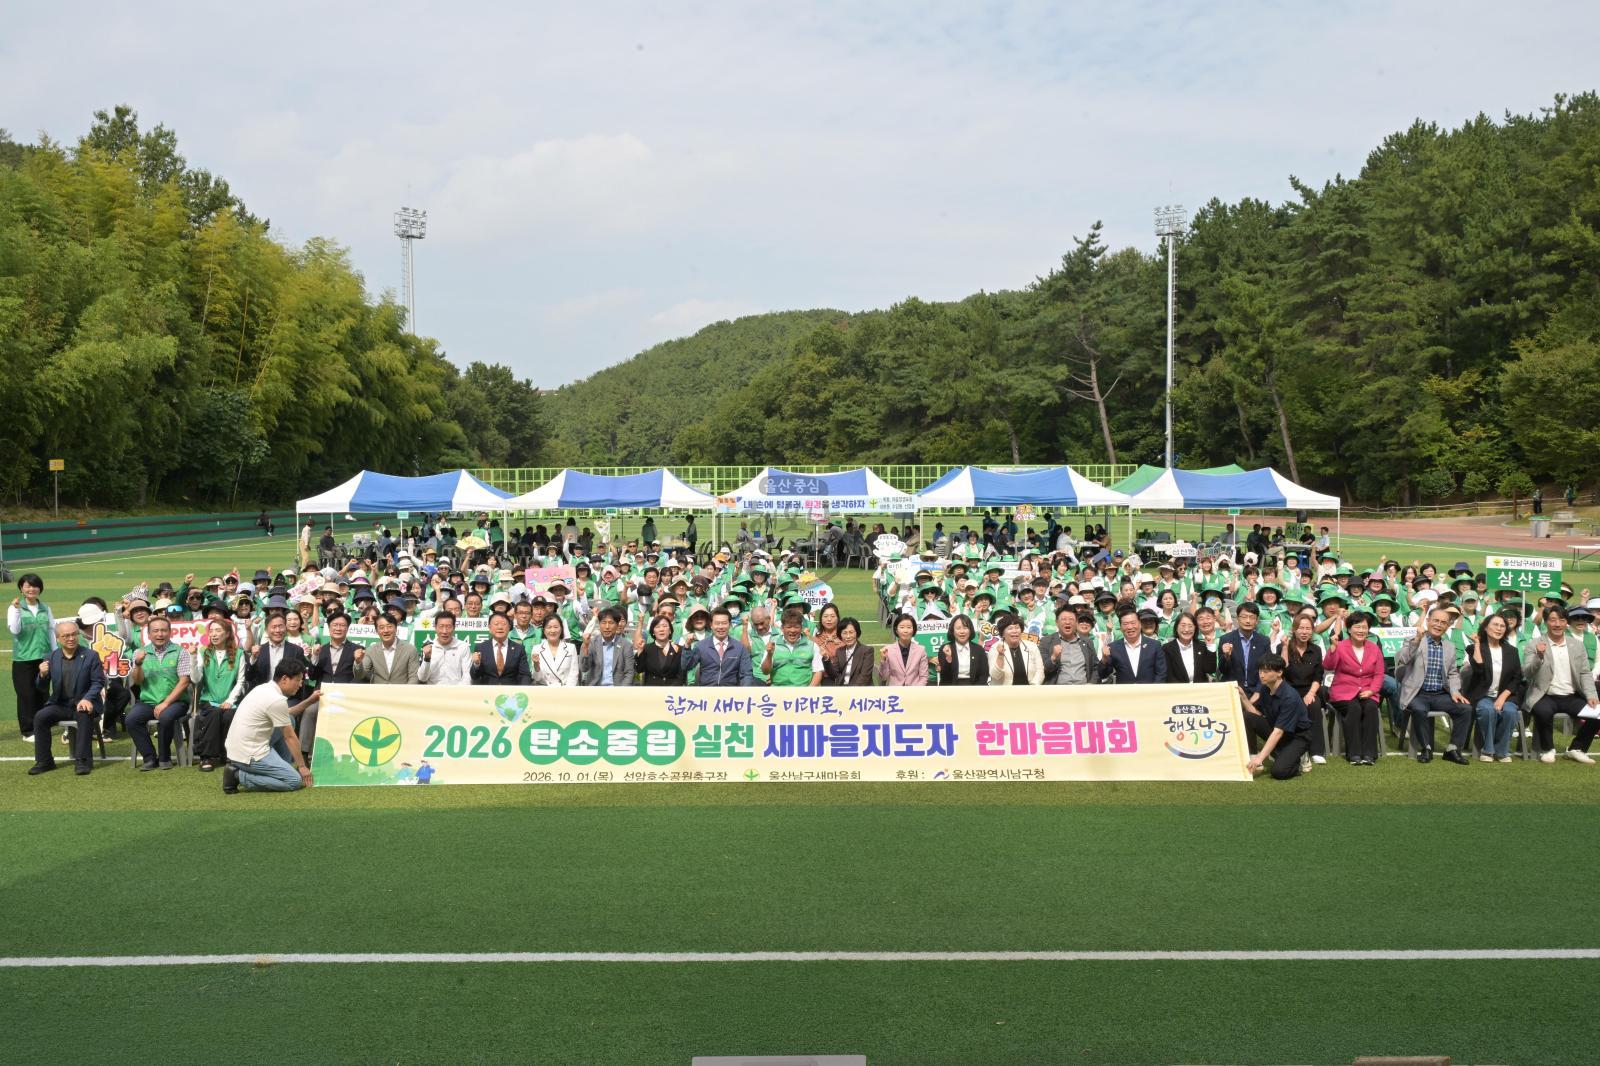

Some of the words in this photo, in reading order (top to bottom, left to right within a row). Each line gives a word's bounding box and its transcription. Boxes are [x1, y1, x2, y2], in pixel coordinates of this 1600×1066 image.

[743, 500, 753, 510] 내
[831, 500, 866, 510] 생각하자
[1503, 559, 1555, 568] 울산남구새마을회
[1498, 571, 1552, 589] 삼산동
[665, 696, 708, 715] 함께
[713, 694, 777, 717] 새마을
[783, 696, 843, 717] 미래로,
[849, 695, 904, 714] 세계로
[1163, 717, 1231, 747] 행복남구
[423, 725, 513, 758] 2026
[529, 728, 677, 757] 탄소중립
[692, 723, 755, 758] 실천
[764, 723, 959, 758] 새마을지도자
[975, 720, 1139, 756] 한마음대회
[523, 771, 552, 782] 2026.
[623, 771, 729, 781] 선암호수공원축구장
[768, 770, 862, 781] 울산남구새마을회
[952, 768, 1046, 780] 울산광역시남구청
